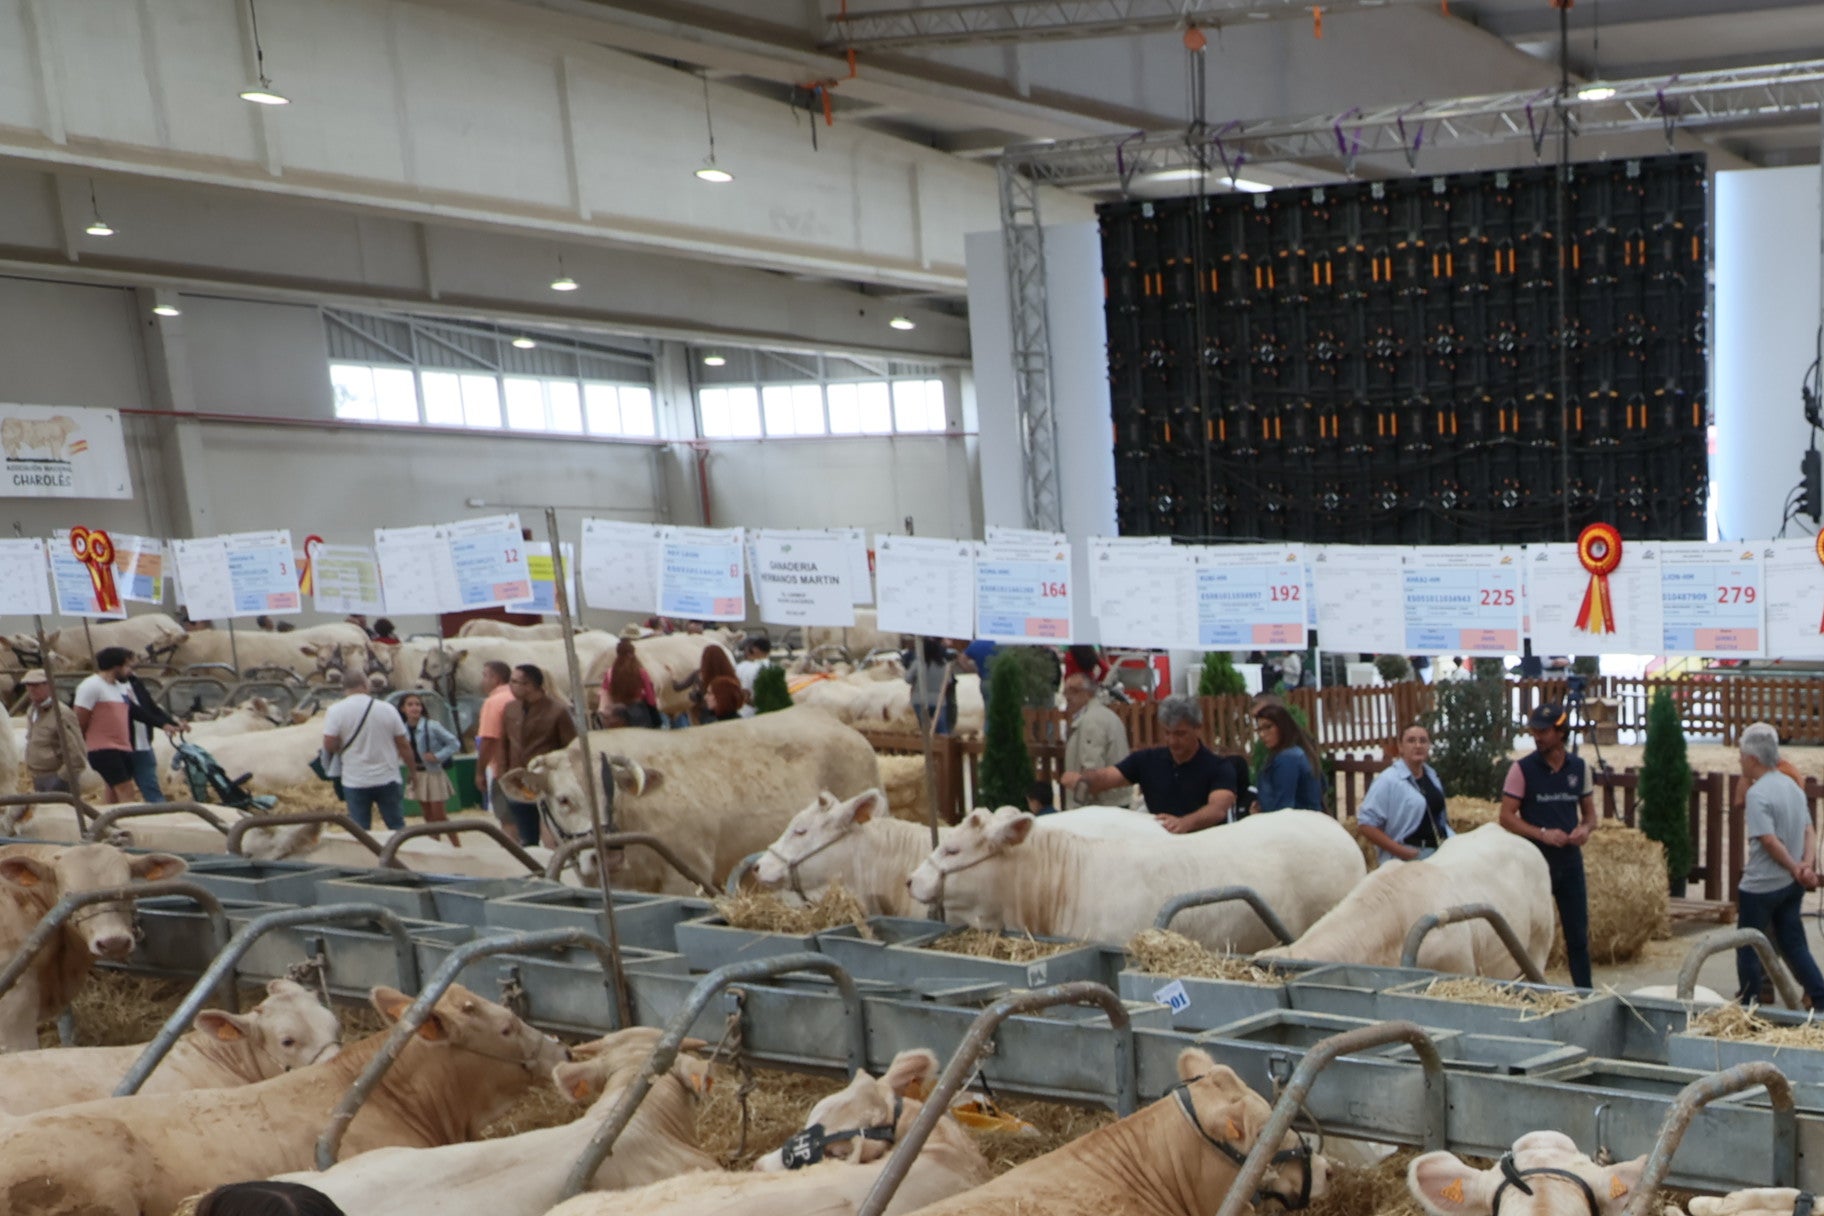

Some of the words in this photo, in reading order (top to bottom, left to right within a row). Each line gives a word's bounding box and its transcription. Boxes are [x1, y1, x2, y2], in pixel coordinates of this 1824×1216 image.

[504, 549, 519, 563] 12
[280, 563, 287, 576] 3
[1042, 582, 1067, 597] 164
[1270, 585, 1300, 601] 192
[1717, 586, 1756, 603] 279
[1480, 589, 1515, 606] 225
